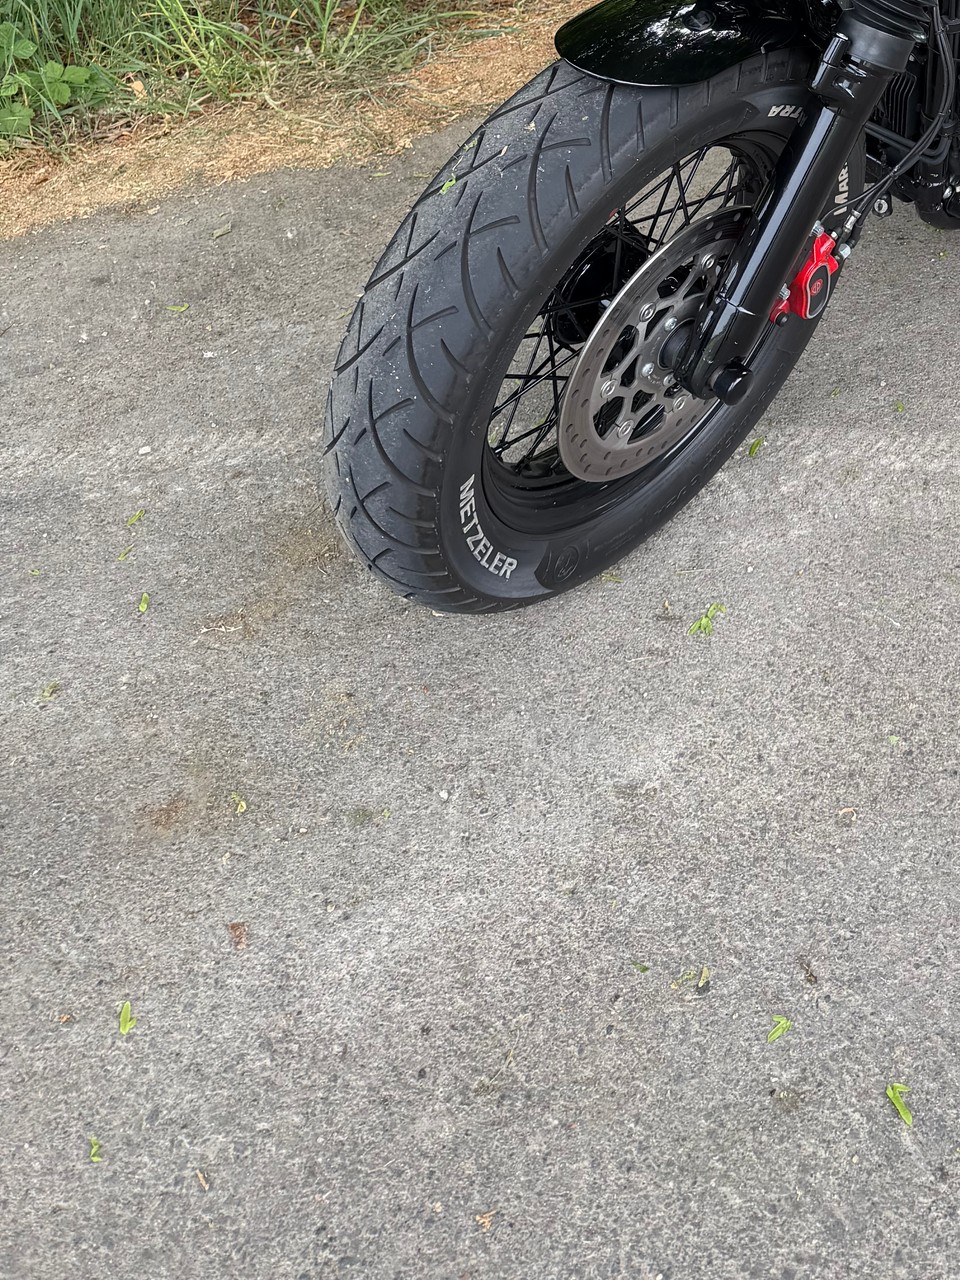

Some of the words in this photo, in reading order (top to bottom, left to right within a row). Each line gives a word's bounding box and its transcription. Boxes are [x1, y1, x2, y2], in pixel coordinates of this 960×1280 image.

[768, 105, 803, 119] TRA
[834, 162, 849, 216] MAR
[460, 474, 518, 579] METZELER
